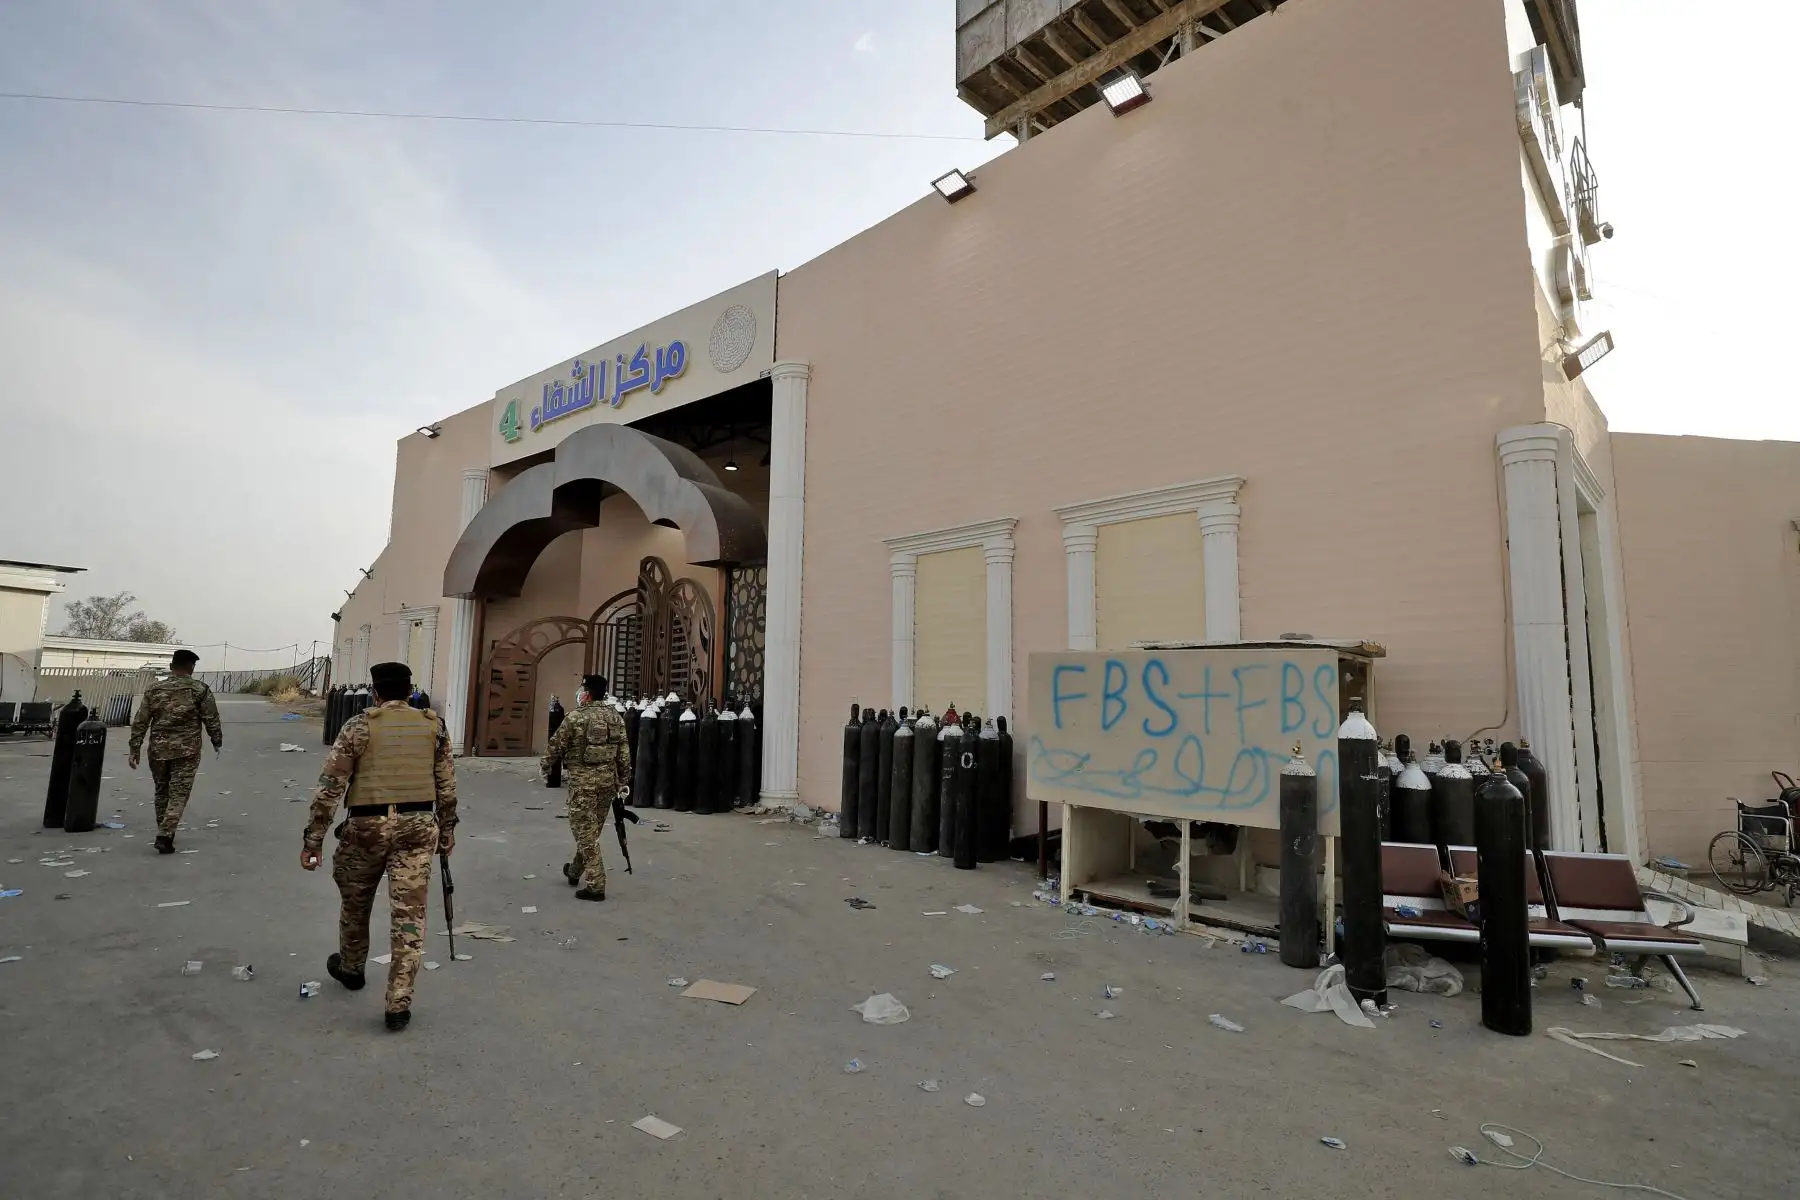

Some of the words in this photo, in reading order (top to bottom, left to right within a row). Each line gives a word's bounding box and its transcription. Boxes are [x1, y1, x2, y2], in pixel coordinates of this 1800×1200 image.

[530, 360, 608, 432] الشفاء
[612, 340, 688, 408] مركز
[499, 398, 522, 443] 4
